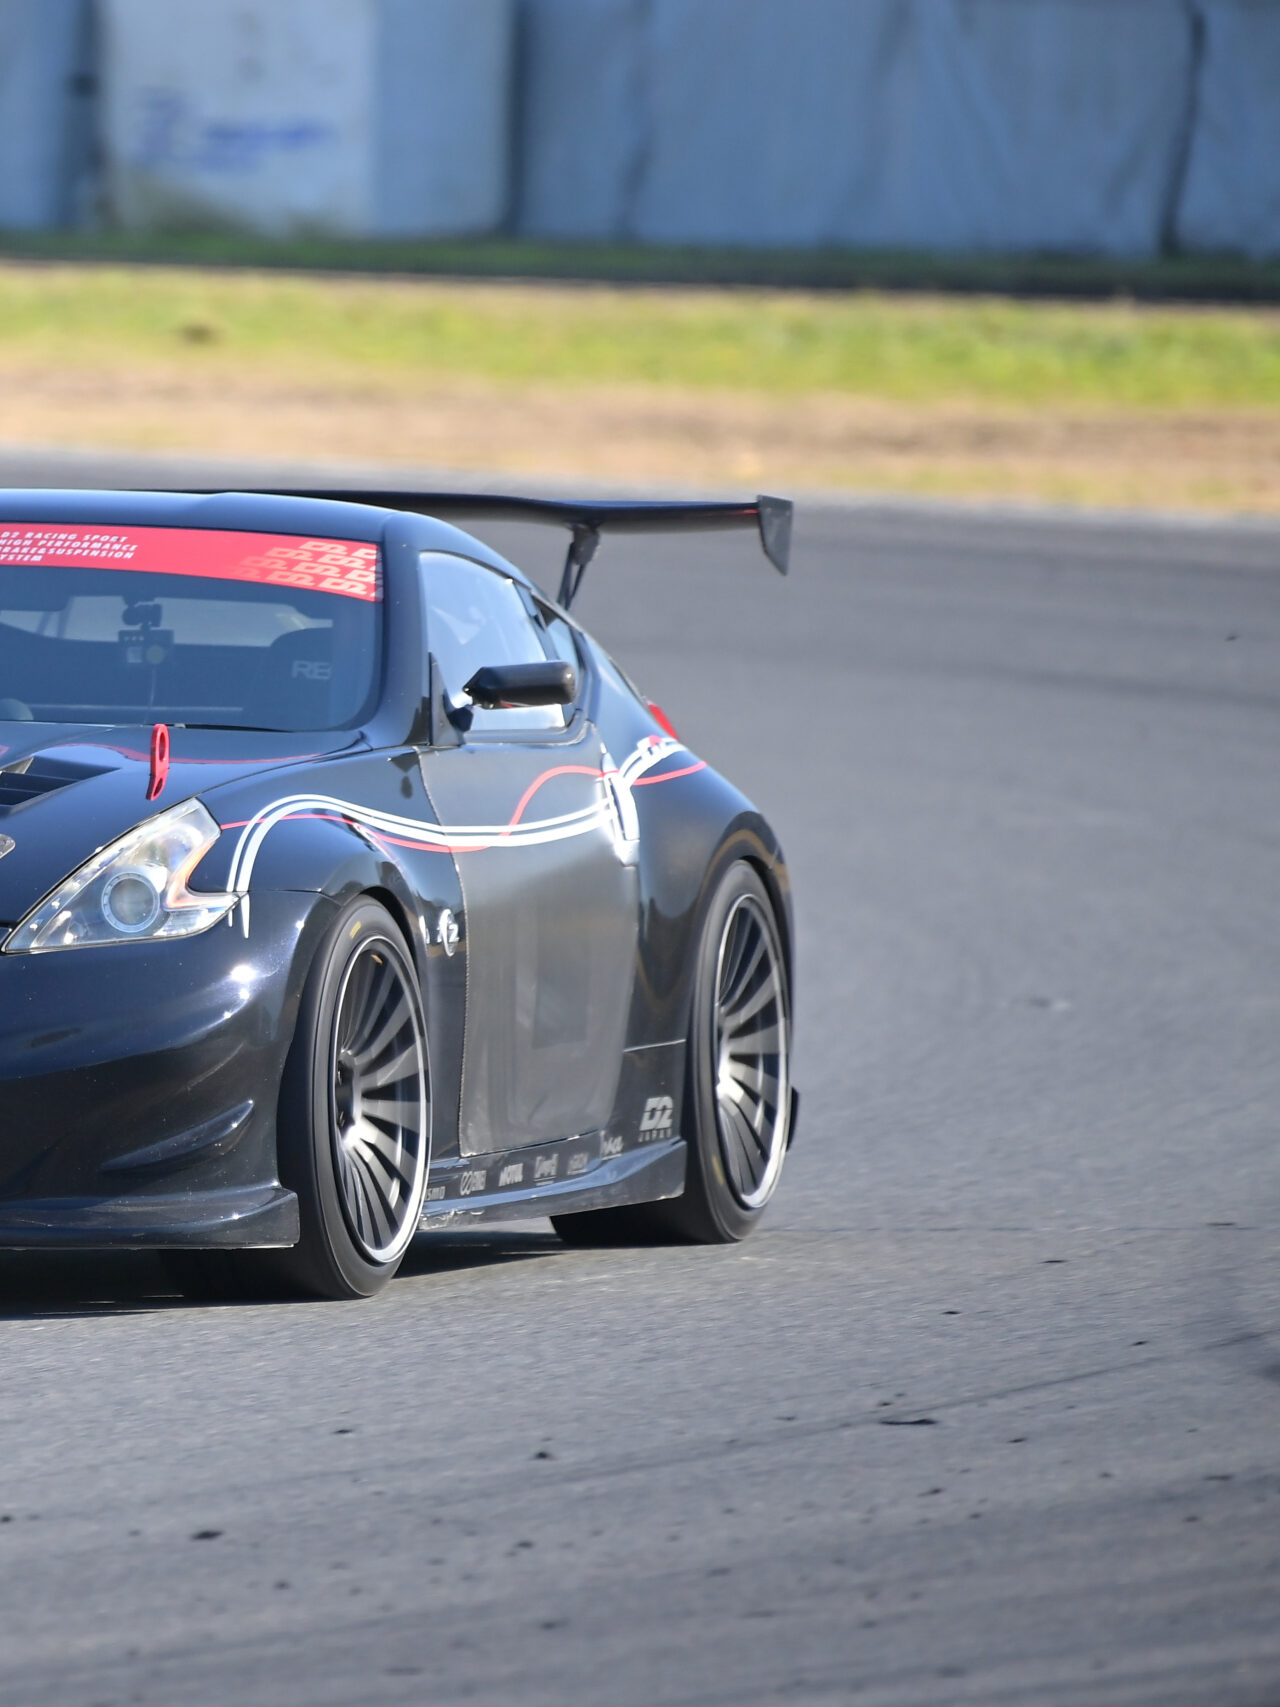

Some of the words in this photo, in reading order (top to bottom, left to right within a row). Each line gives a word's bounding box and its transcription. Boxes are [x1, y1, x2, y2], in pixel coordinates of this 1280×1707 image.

[1, 531, 20, 539] D2
[24, 531, 78, 540] RACING
[83, 534, 128, 543] SPORT
[37, 540, 138, 551] PERFORMANCE
[640, 1096, 673, 1131] D2
